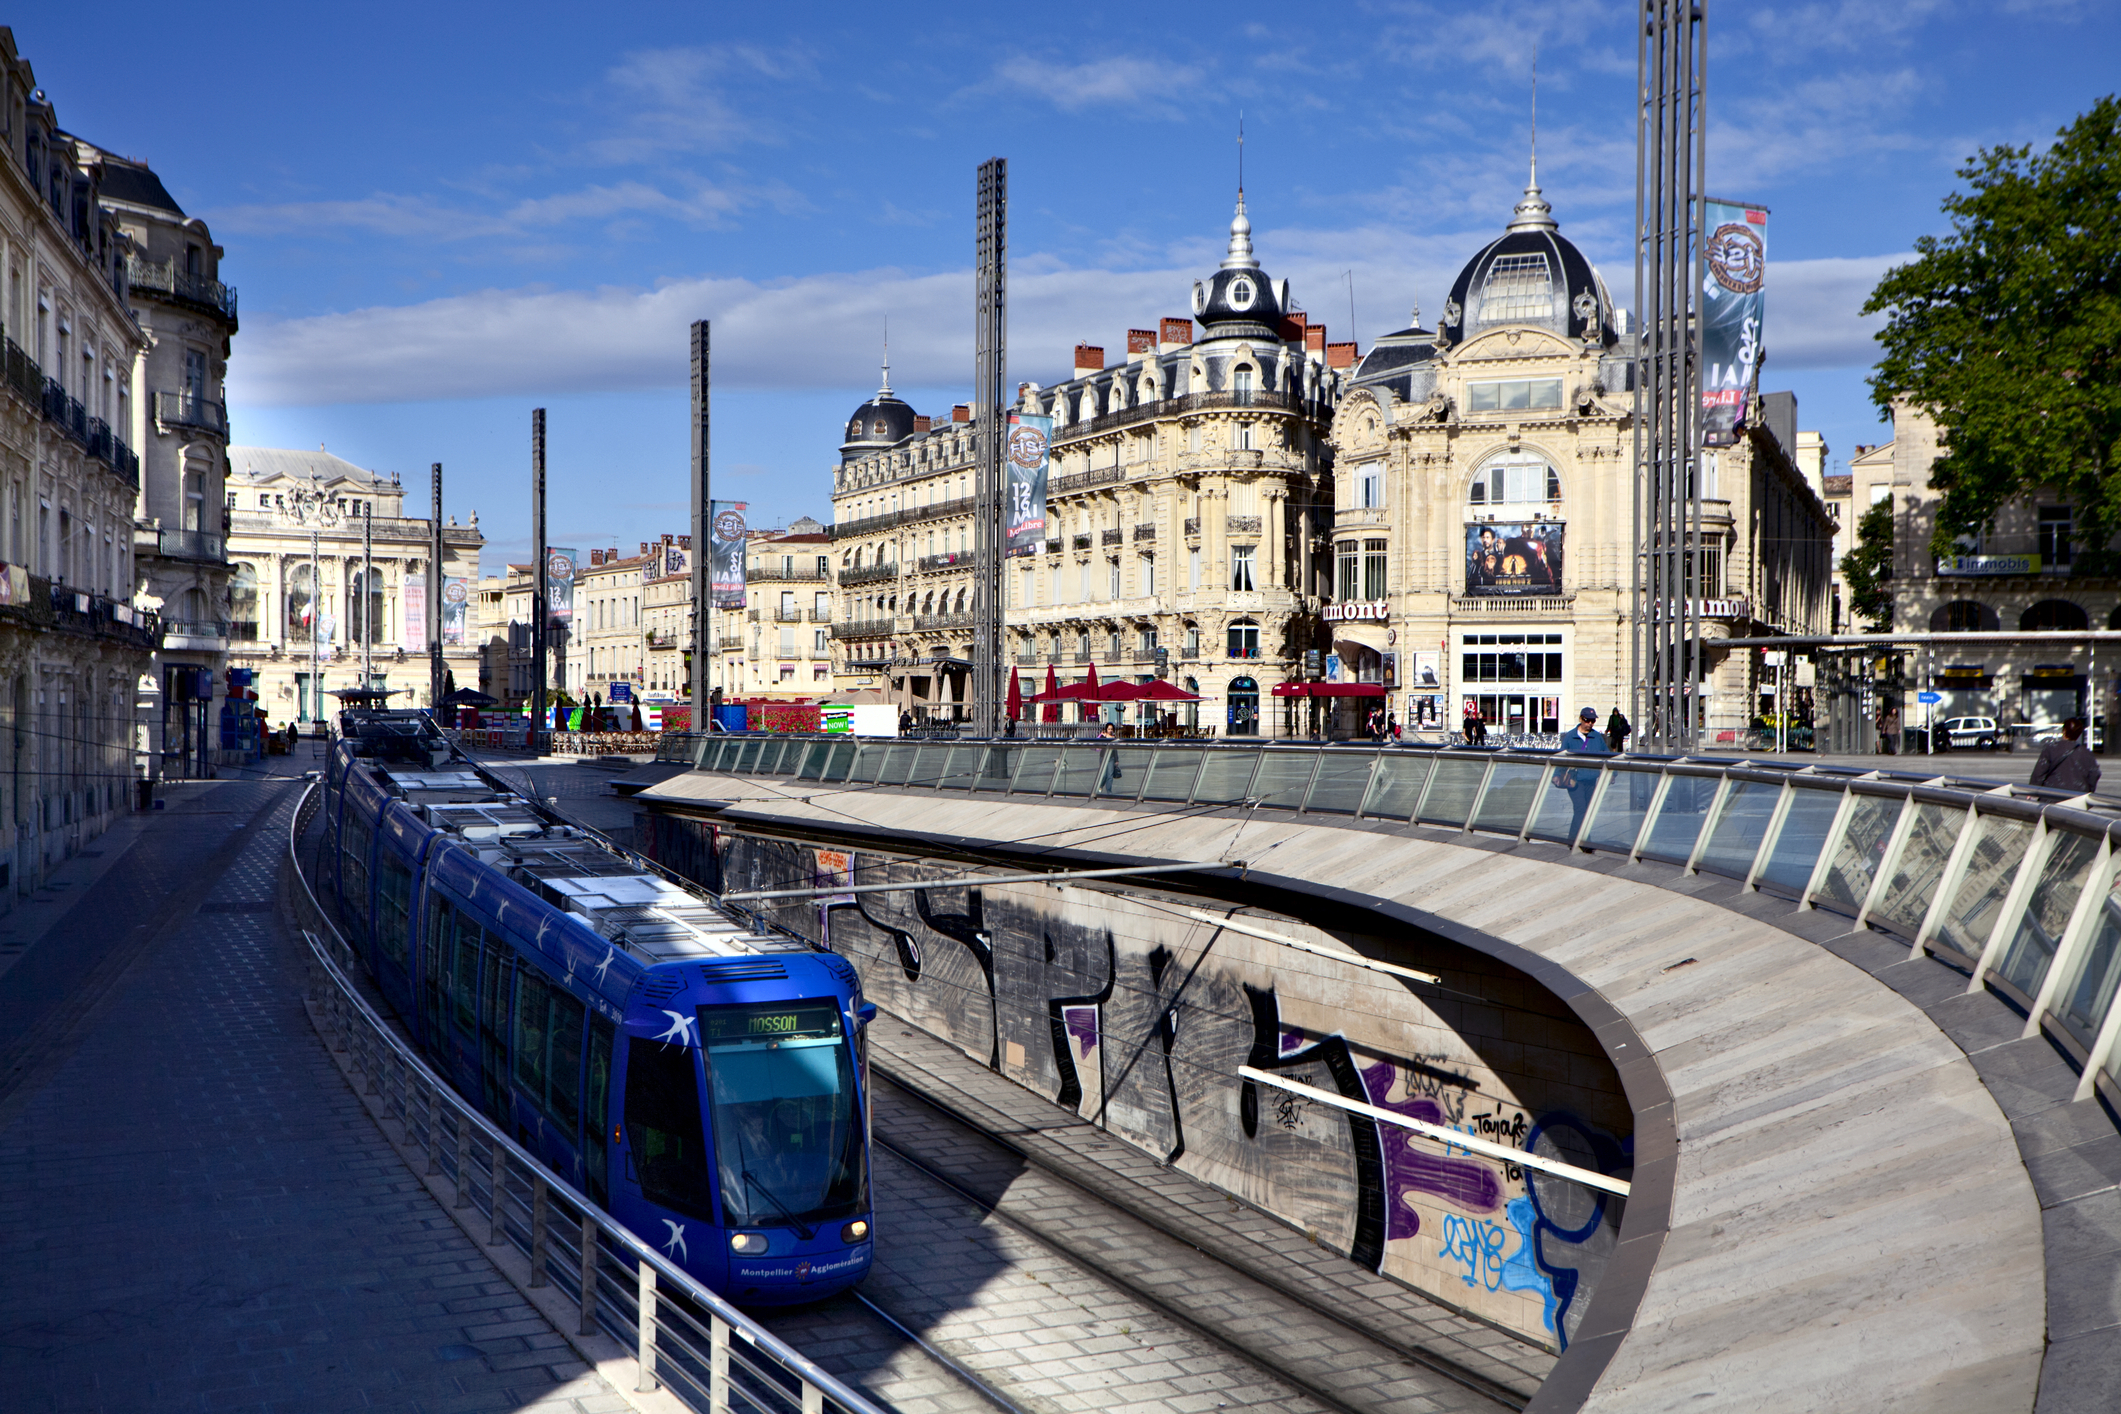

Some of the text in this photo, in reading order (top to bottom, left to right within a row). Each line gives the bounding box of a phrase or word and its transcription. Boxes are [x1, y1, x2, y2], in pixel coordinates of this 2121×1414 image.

[1010, 439, 1046, 458] FISE
[1012, 482, 1031, 498] 12
[1013, 496, 1031, 511] 16
[1013, 504, 1038, 526] MAI
[1021, 521, 1042, 531] Libre
[1966, 557, 2030, 569] immobis
[549, 586, 561, 596] 12
[549, 594, 562, 603] 16
[550, 601, 569, 611] MAI
[1230, 648, 1259, 659] CIC
[1467, 702, 1476, 713] Q
[748, 1015, 798, 1033] MOSSON
[740, 1268, 793, 1278] Montpellier
[811, 1256, 864, 1274] Agglomération
